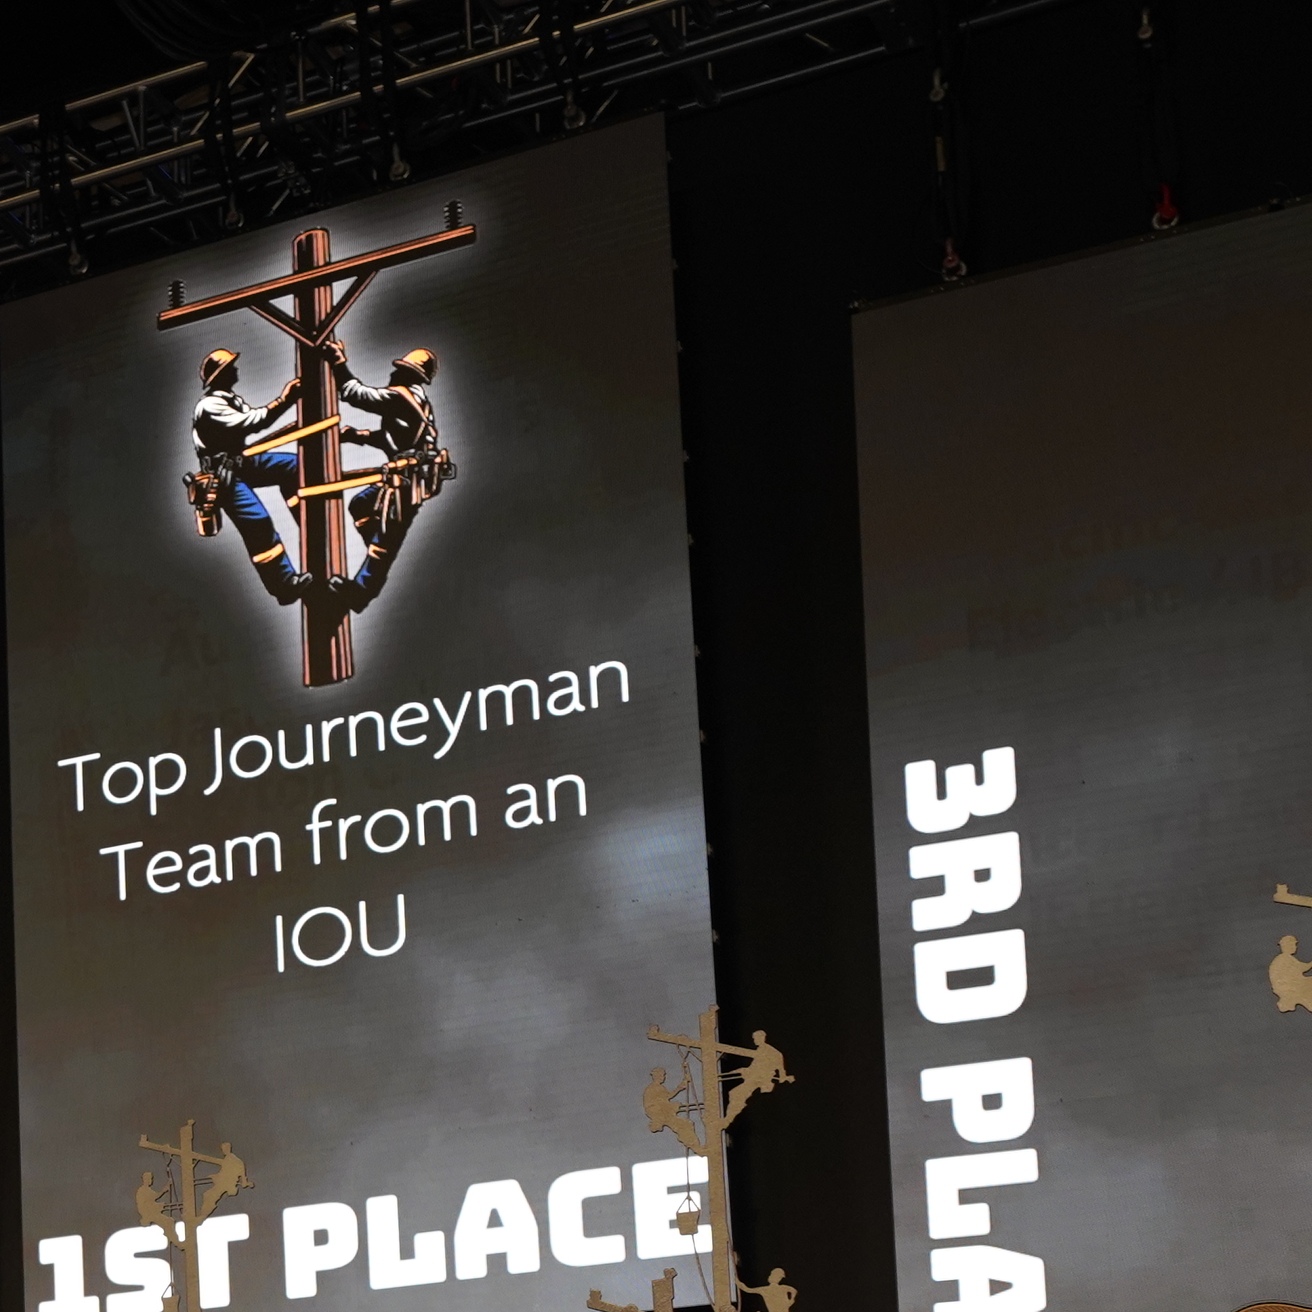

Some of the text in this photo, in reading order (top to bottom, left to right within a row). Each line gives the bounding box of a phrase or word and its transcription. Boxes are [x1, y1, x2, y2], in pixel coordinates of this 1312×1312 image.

[57, 658, 630, 816] Top Journeyman
[99, 771, 589, 901] Team from an
[904, 746, 1029, 1025] 3RD
[275, 893, 408, 973] IOU
[282, 1155, 714, 1300] PLACE
